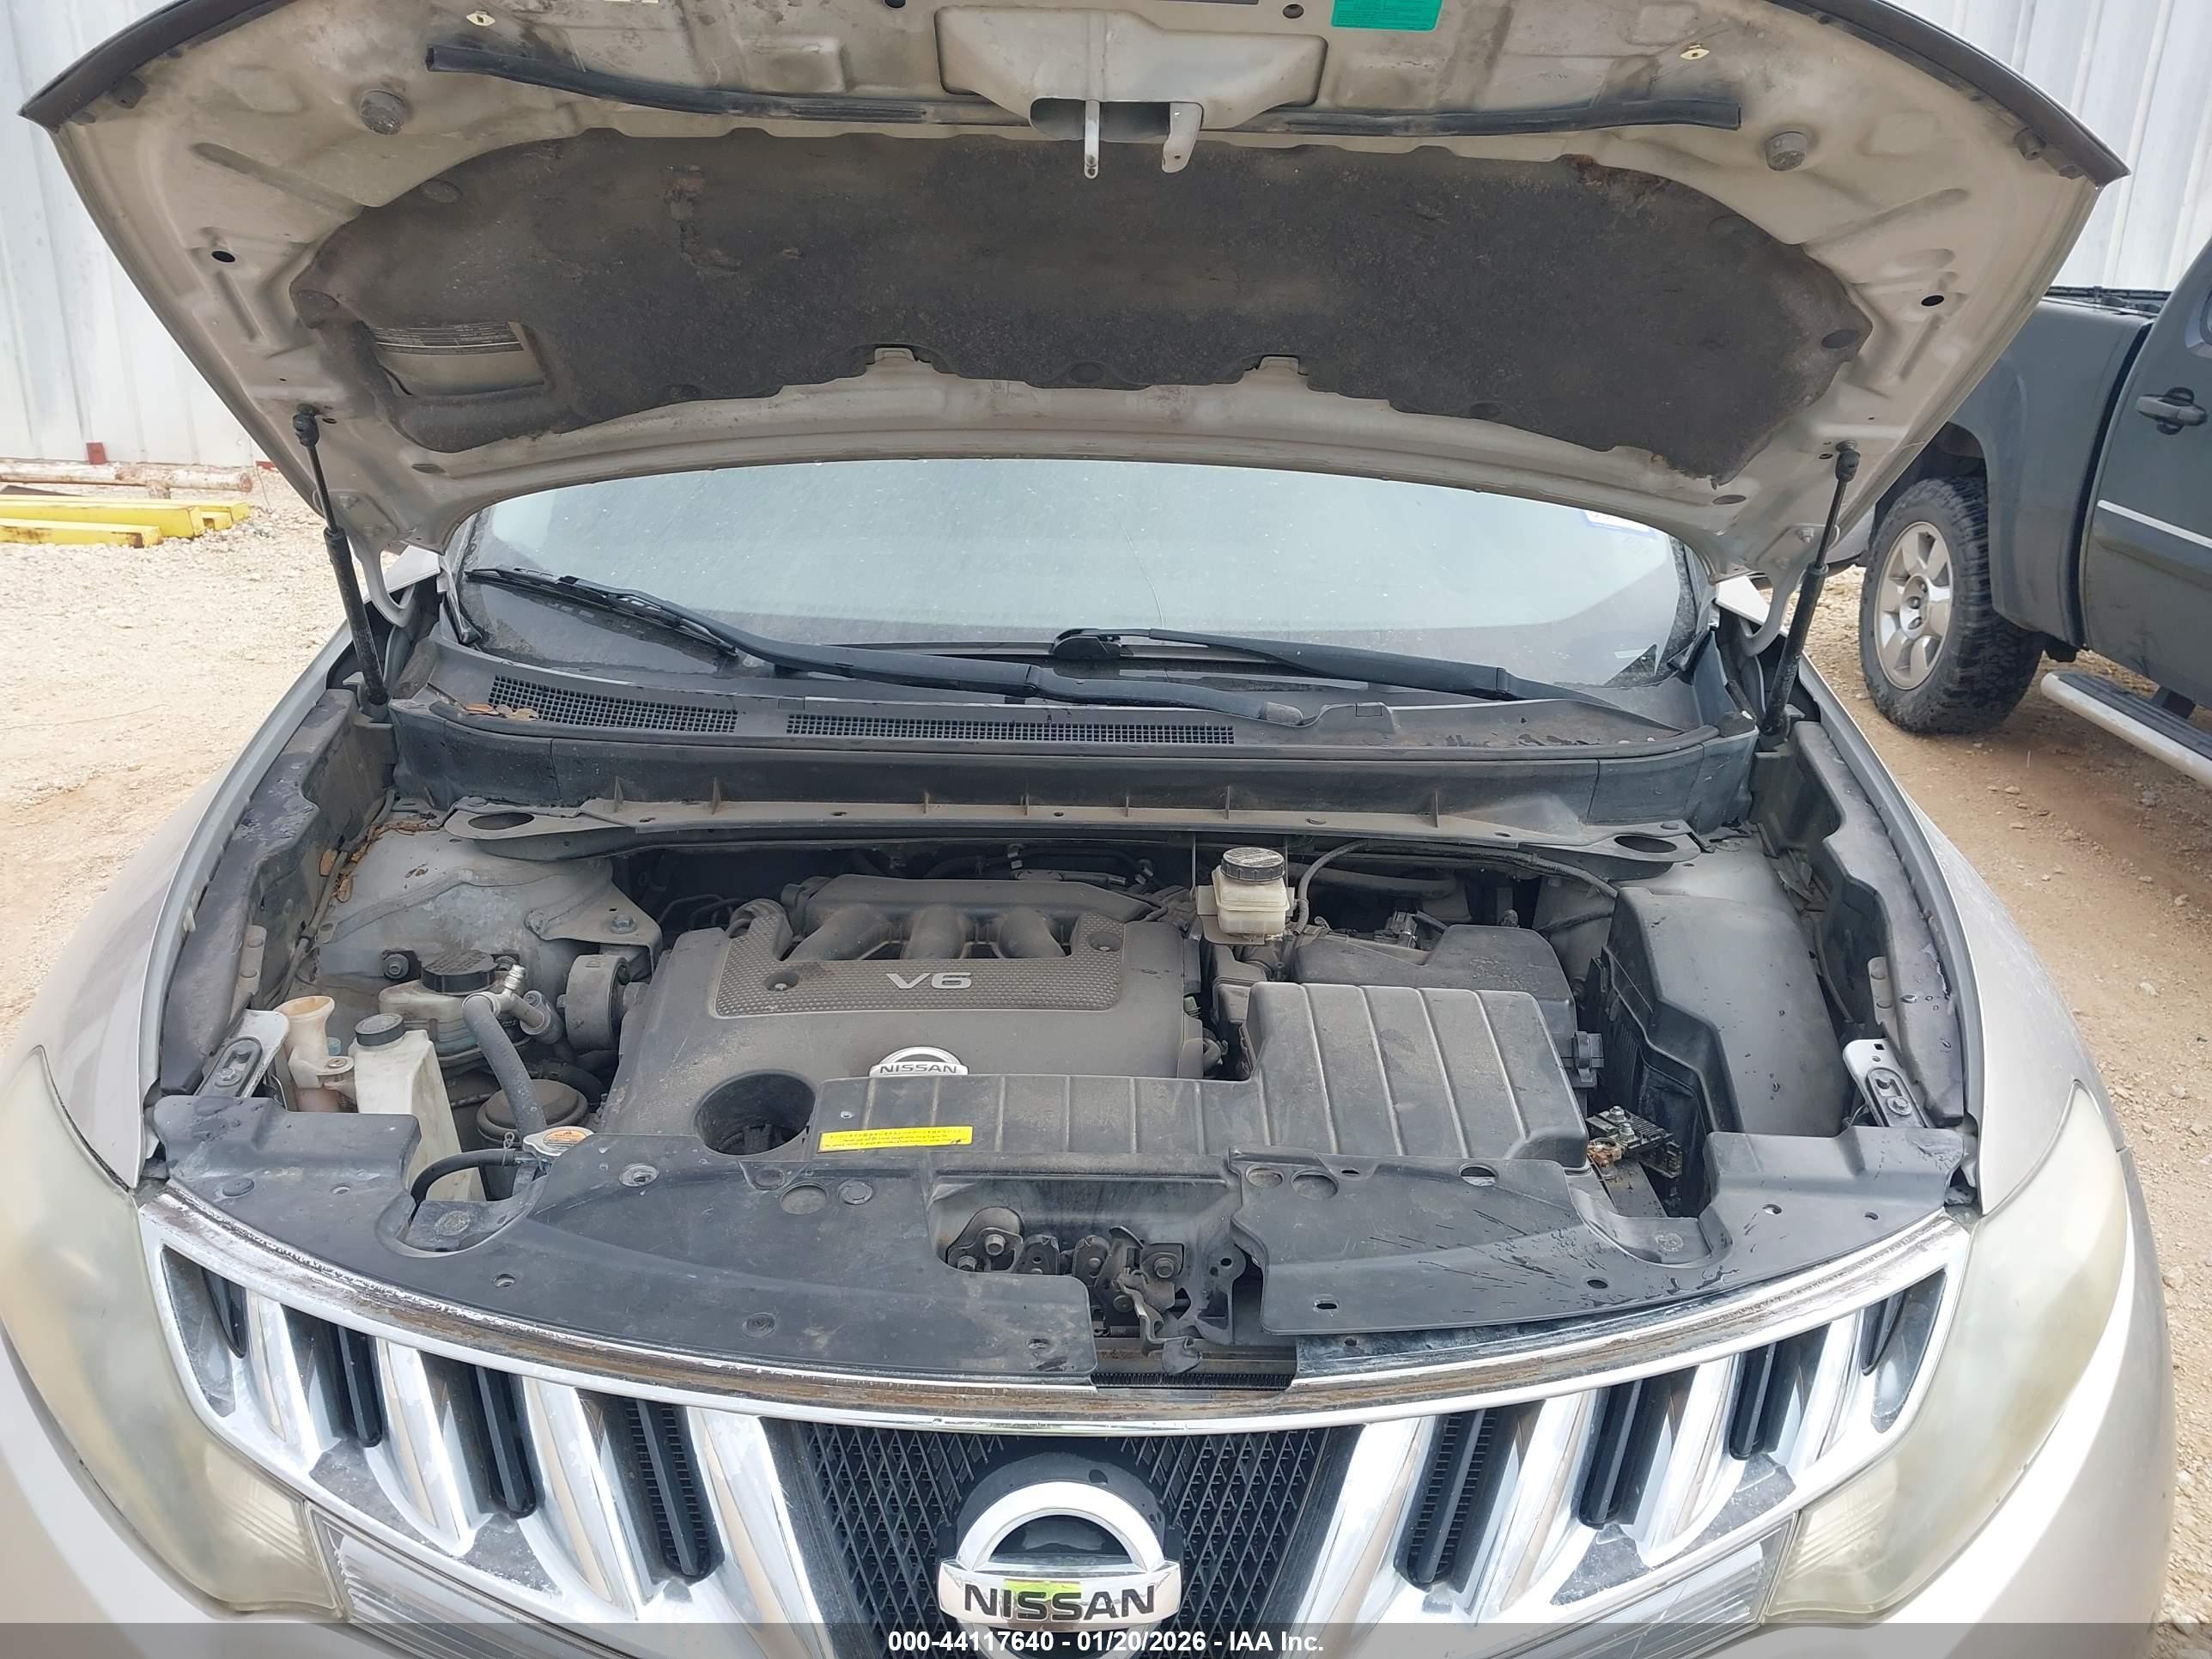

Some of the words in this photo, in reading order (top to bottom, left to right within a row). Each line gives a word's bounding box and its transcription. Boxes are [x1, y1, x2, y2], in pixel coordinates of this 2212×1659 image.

[885, 971, 972, 989] V6
[879, 1064, 957, 1074] NISSAN
[963, 1583, 1156, 1622] NISSAN
